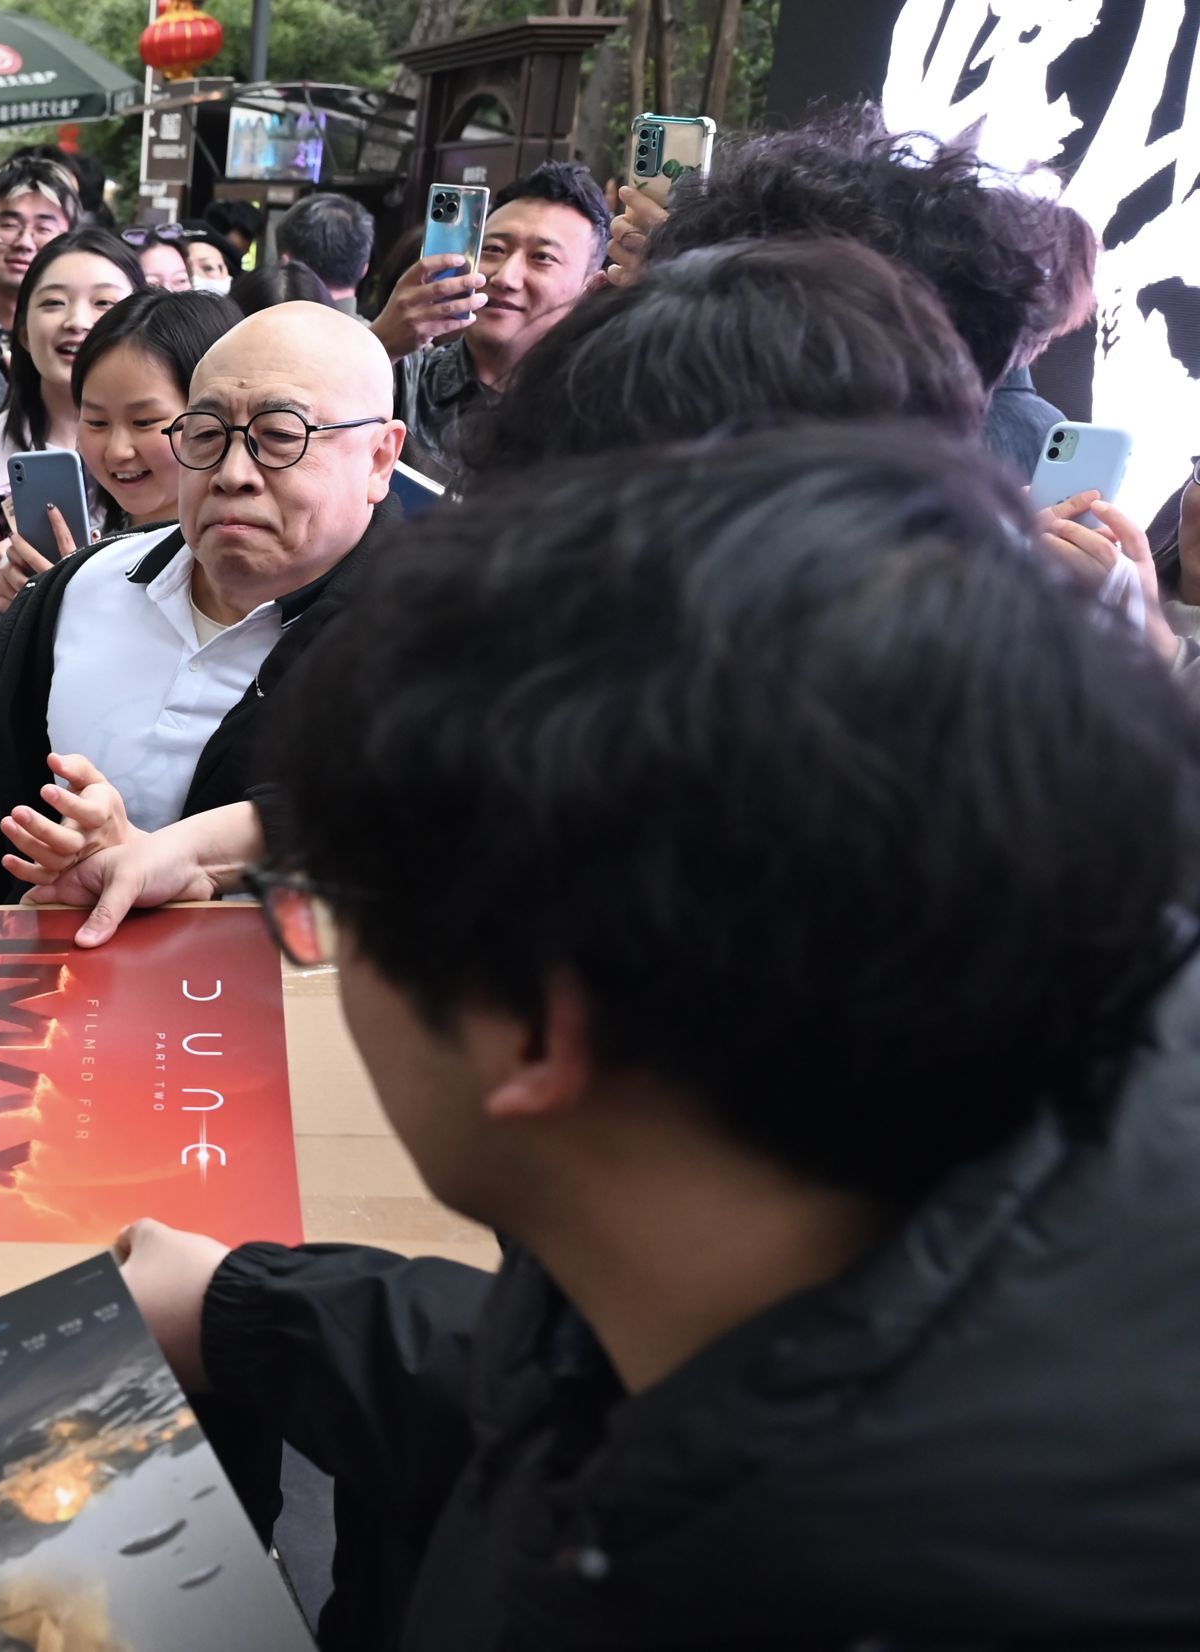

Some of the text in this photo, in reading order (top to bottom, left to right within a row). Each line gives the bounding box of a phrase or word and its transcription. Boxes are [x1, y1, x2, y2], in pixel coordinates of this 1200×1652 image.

[73, 999, 100, 1141] FILMED FOR
[152, 1032, 167, 1113] PART TWO
